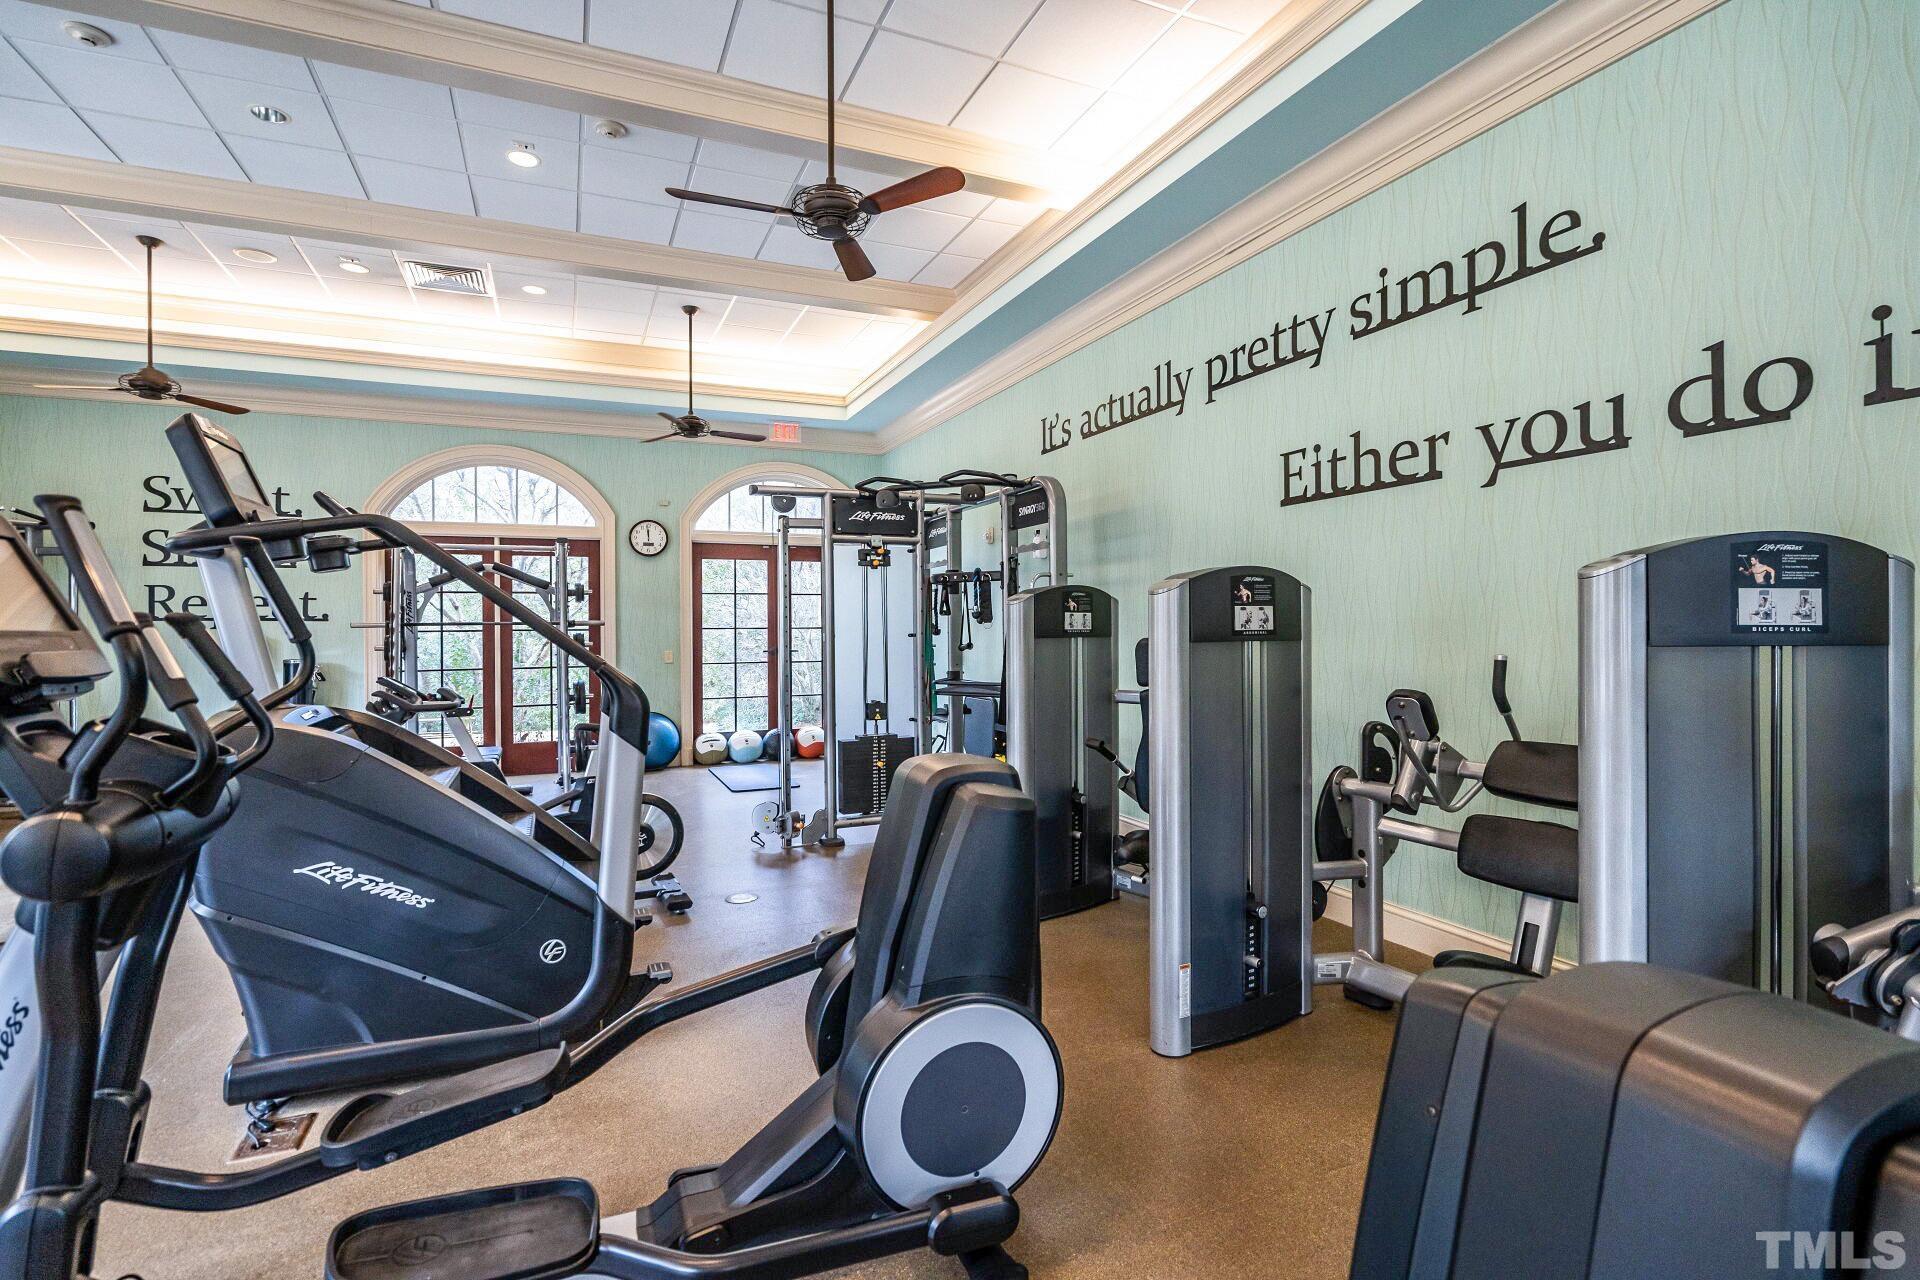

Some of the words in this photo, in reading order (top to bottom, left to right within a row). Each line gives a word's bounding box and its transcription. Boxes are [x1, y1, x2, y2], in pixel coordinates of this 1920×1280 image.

[1040, 413, 1071, 455] It's
[1080, 360, 1193, 440] actually
[1205, 307, 1336, 404] pretty
[1350, 201, 1606, 340] simple.
[1280, 430, 1450, 507] Either
[1475, 393, 1632, 488] you
[1668, 340, 1814, 438] do
[1864, 305, 1920, 407] i
[142, 475, 302, 517] Swt.
